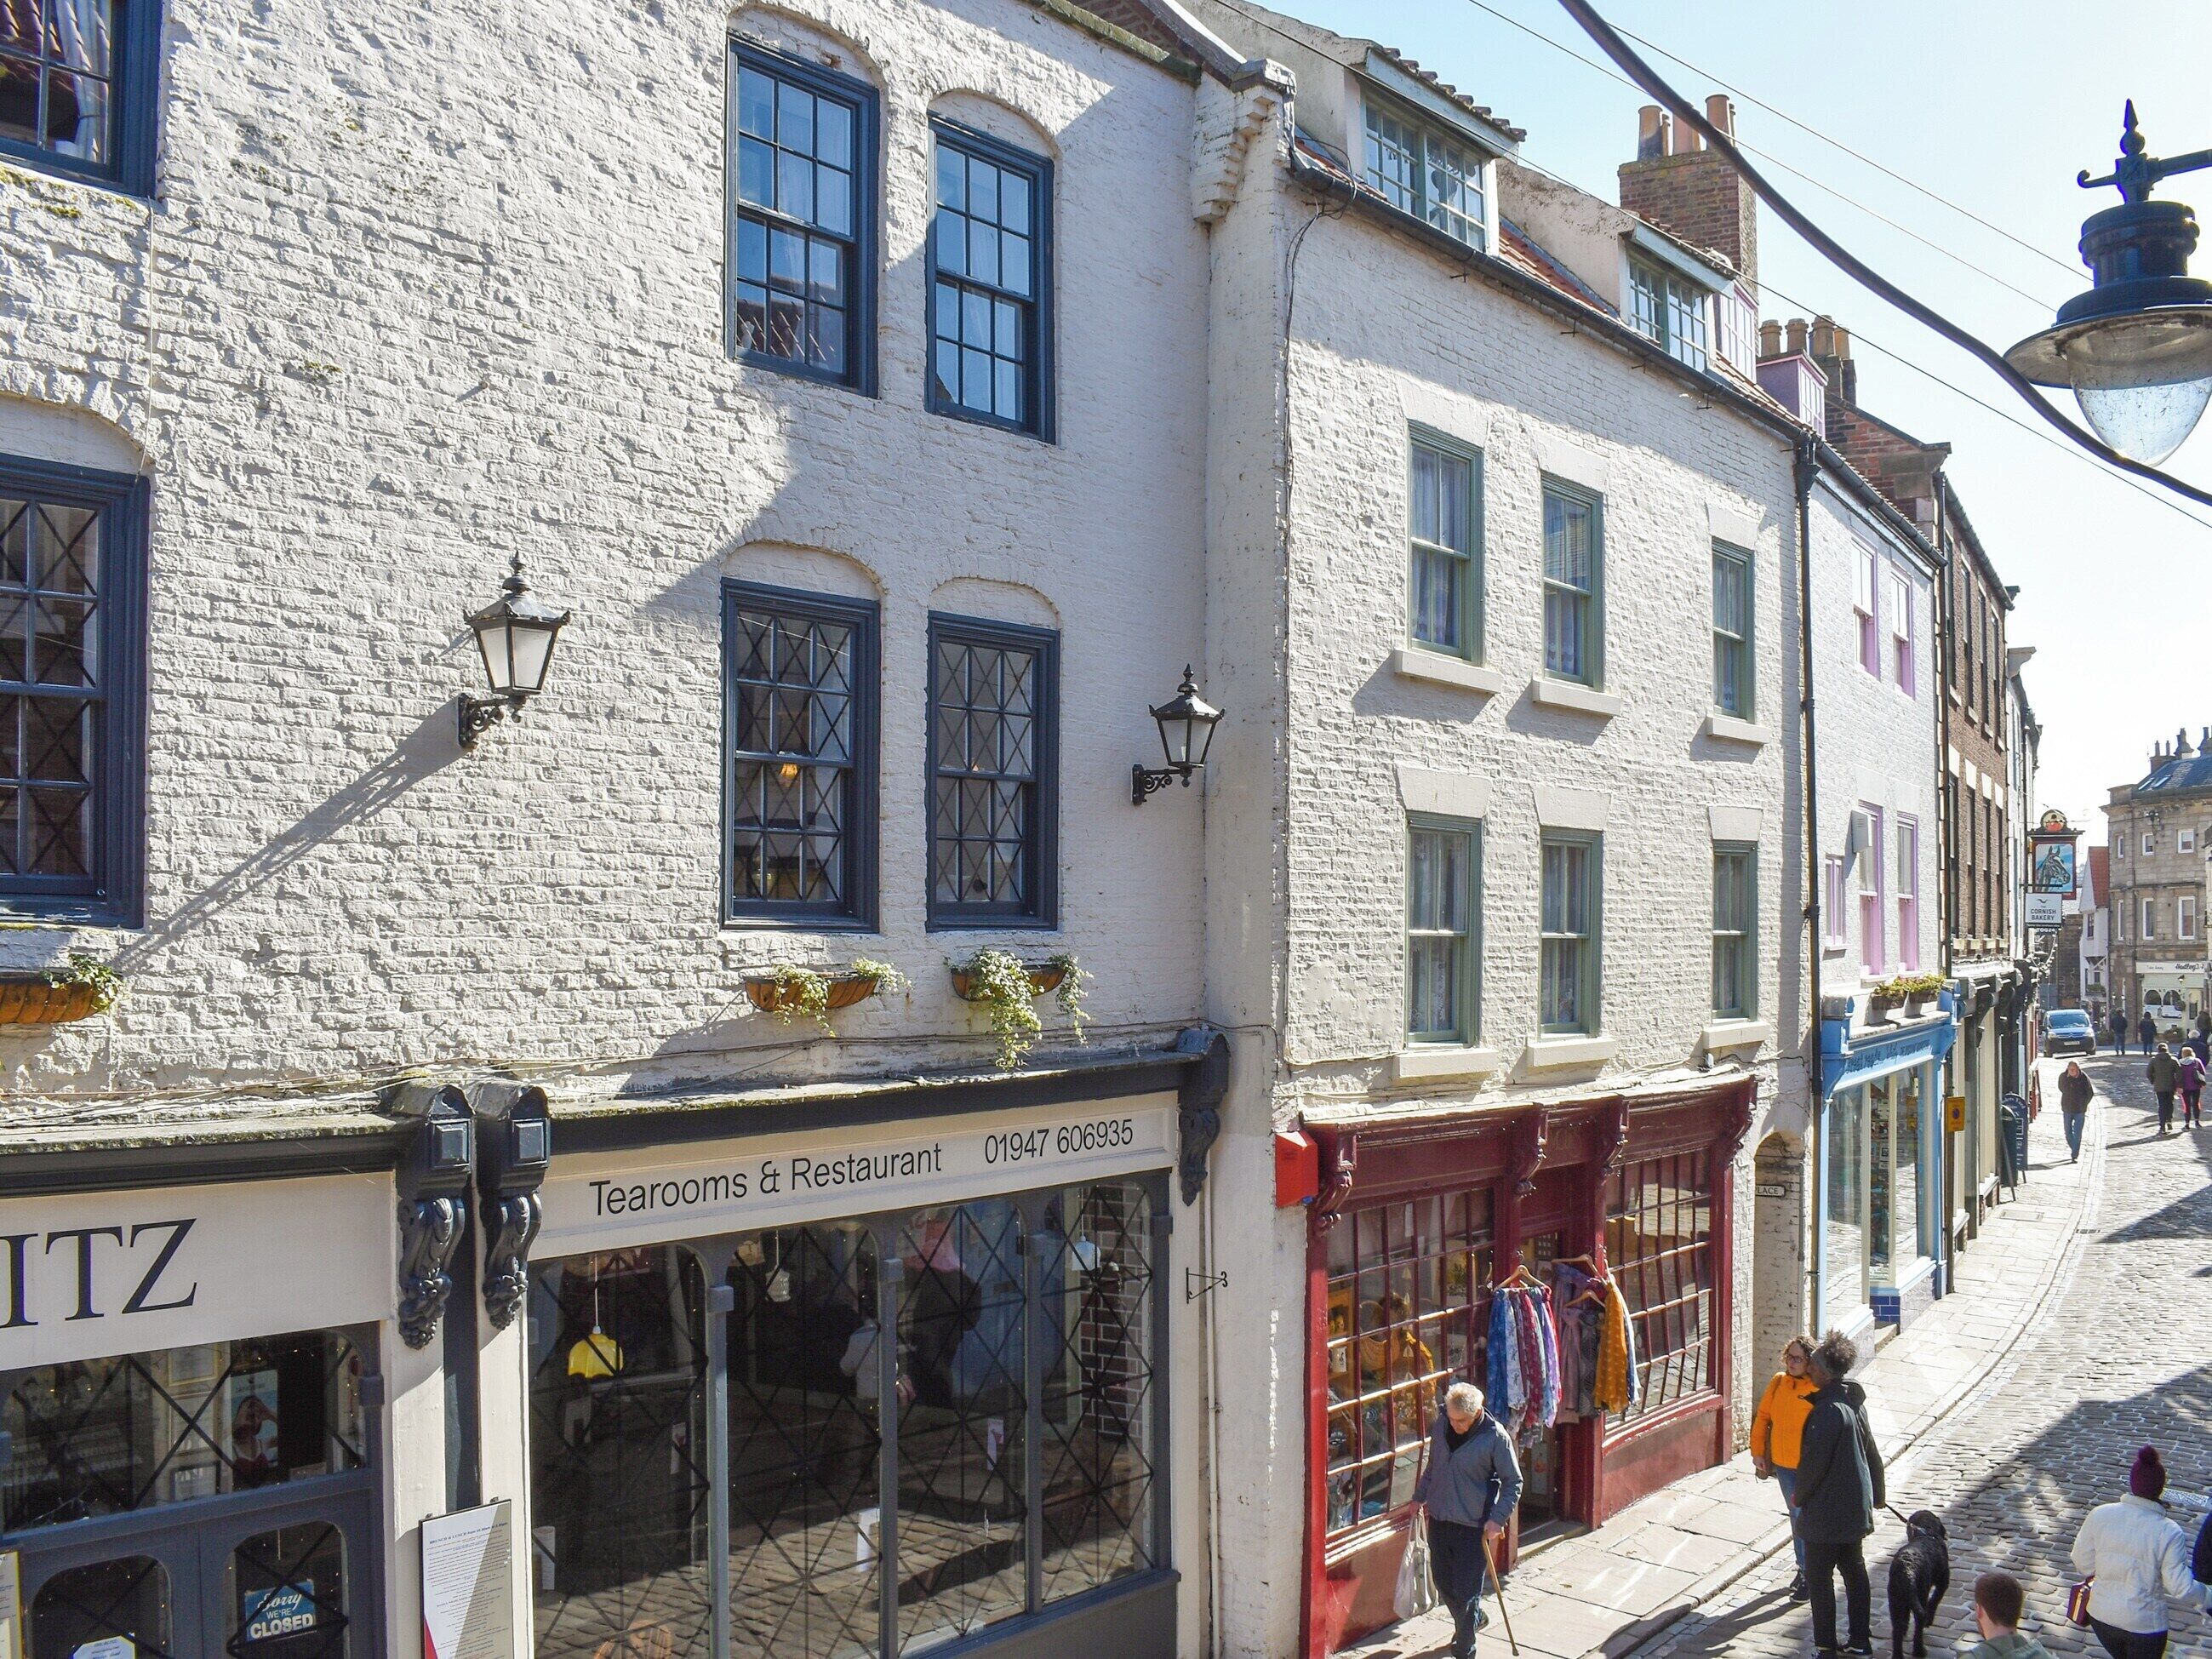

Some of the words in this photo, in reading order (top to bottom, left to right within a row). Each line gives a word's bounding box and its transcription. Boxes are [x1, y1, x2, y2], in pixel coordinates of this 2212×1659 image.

[589, 1172, 748, 1216] Tearooms
[759, 1160, 780, 1194] &
[792, 1142, 942, 1191] Restaurant
[985, 1128, 1049, 1164] 01947
[1057, 1118, 1133, 1154] 606935
[0, 1218, 197, 1329] ITZ
[257, 1593, 302, 1612] Sorry
[266, 1607, 292, 1619] WE'RE
[250, 1613, 314, 1639] CLOSED
